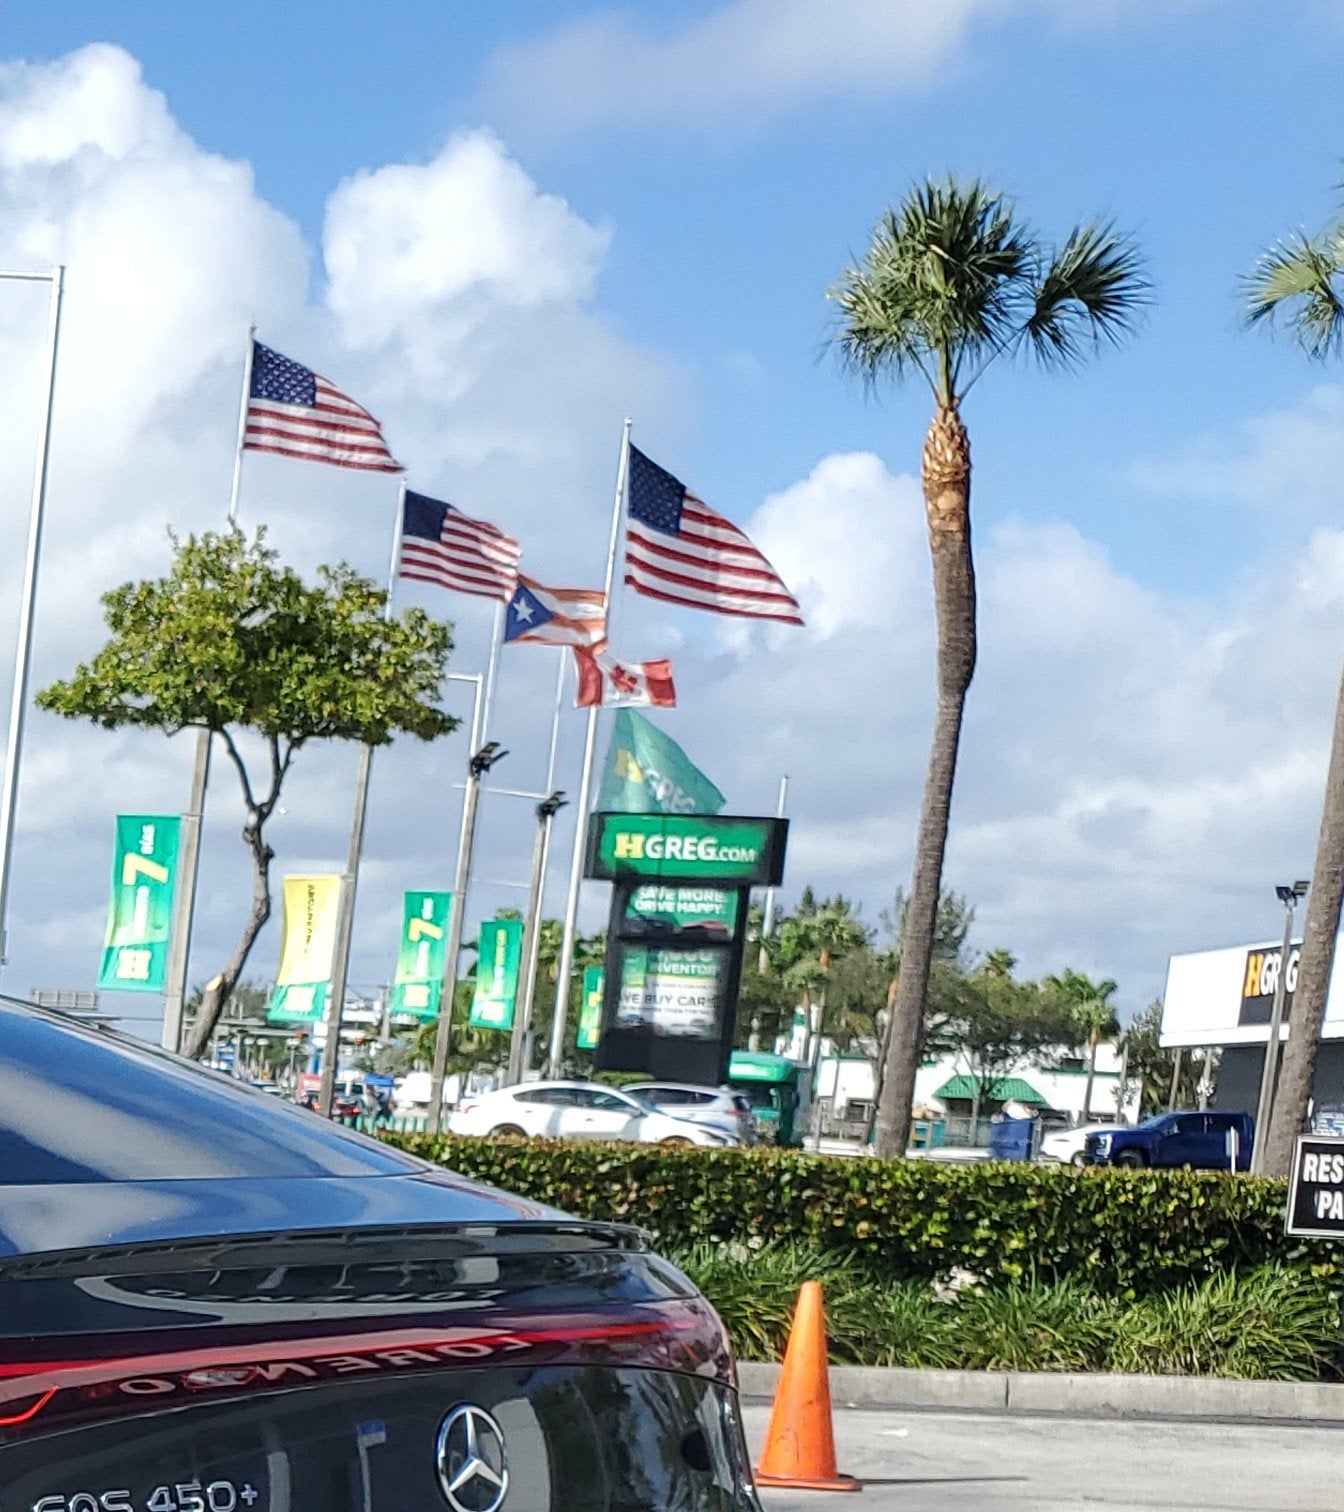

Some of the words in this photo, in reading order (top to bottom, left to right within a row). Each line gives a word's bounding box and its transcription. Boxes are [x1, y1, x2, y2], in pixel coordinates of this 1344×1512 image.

[122, 852, 169, 886] 7
[408, 917, 443, 942] 7
[1244, 949, 1300, 997] HGRG
